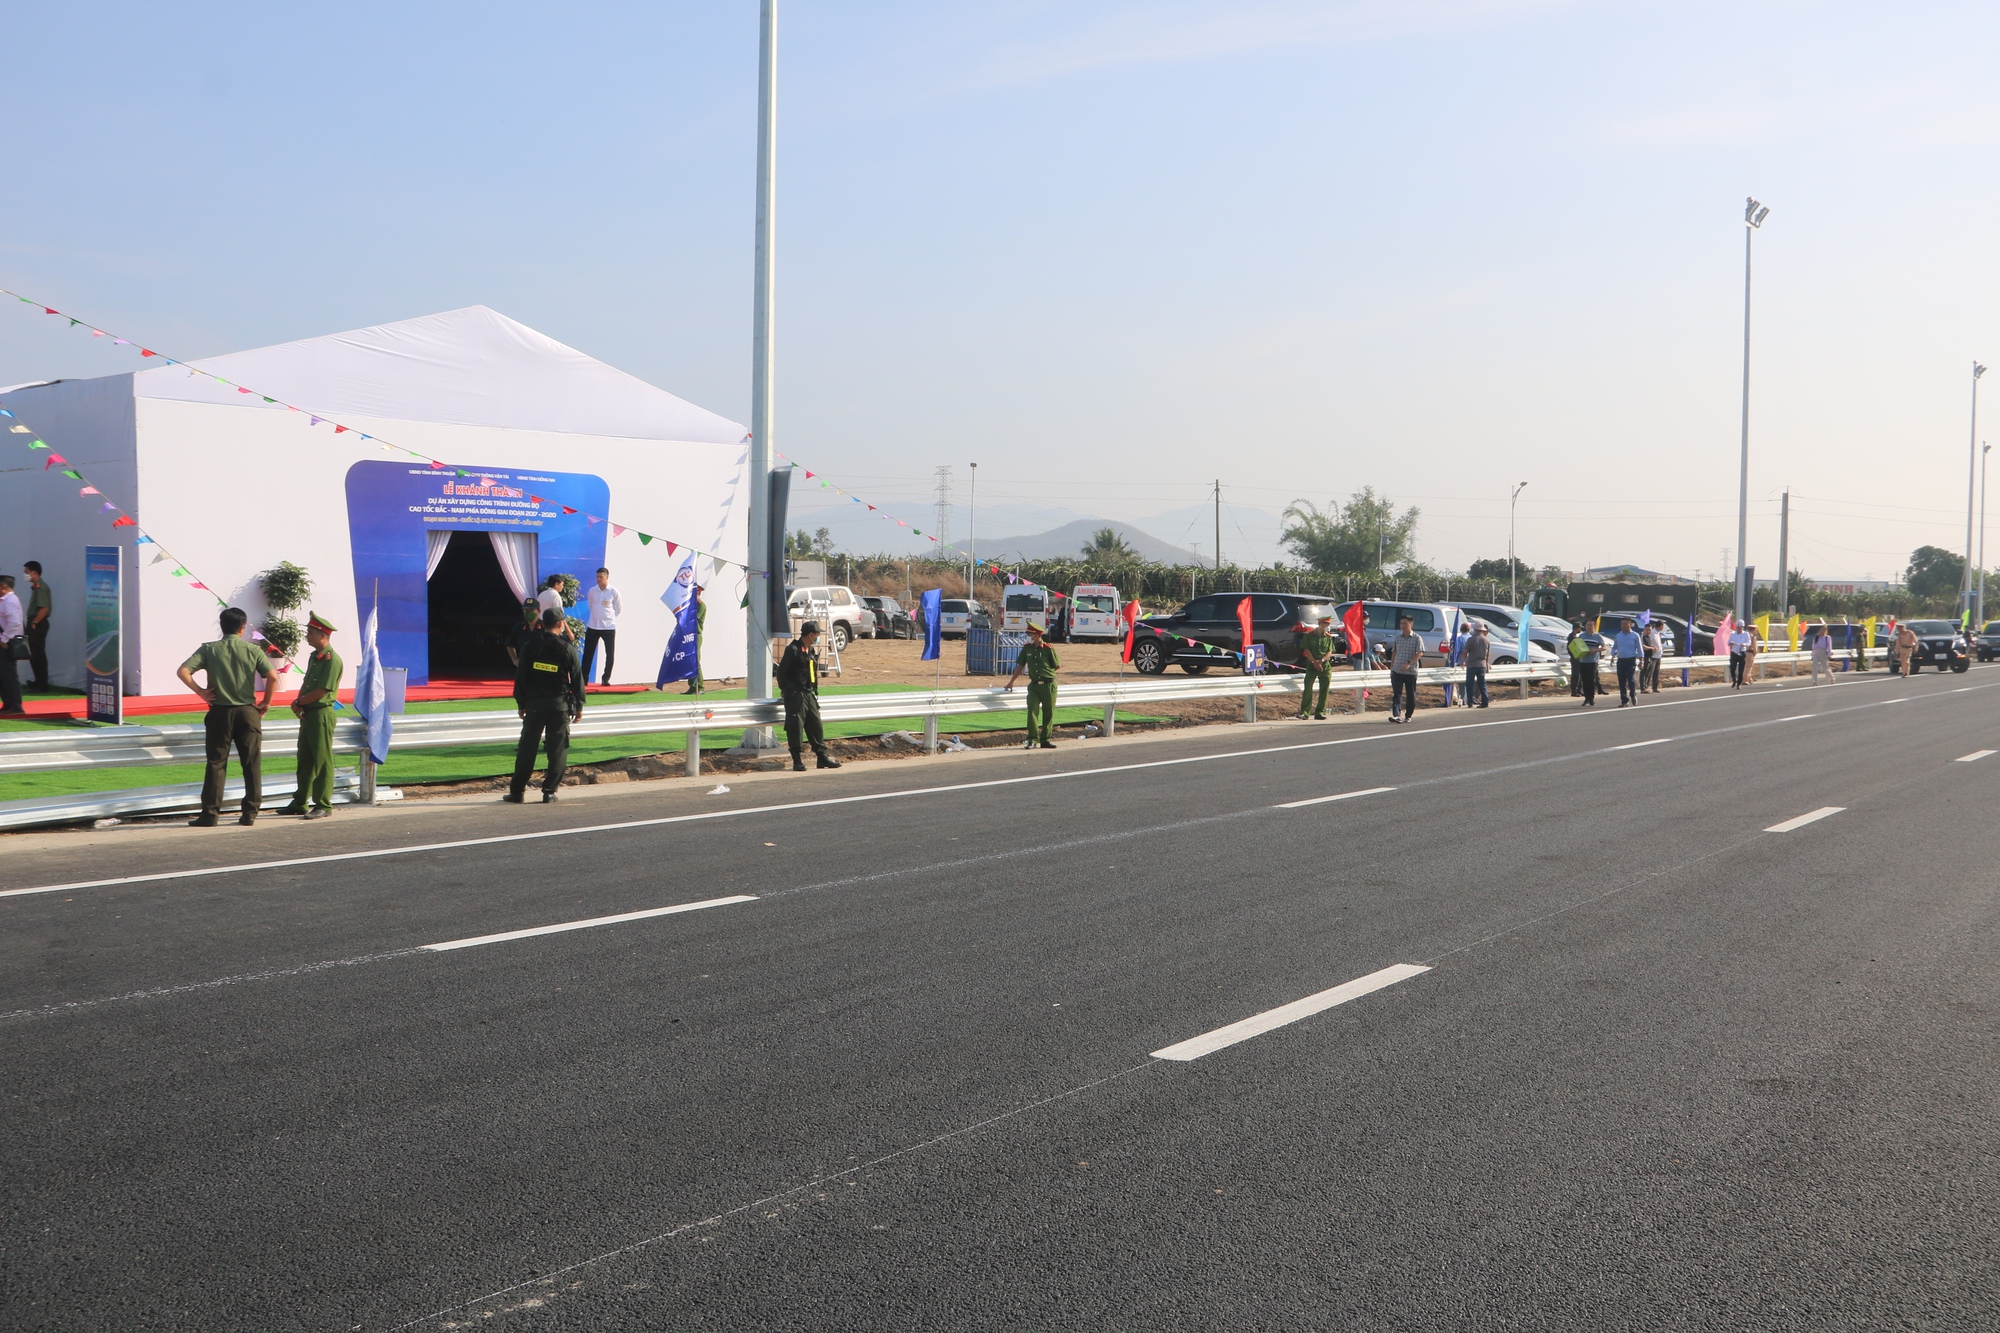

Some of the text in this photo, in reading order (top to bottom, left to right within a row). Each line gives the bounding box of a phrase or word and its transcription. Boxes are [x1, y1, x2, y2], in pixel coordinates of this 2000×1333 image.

[444, 480, 522, 498] LỄ KHÁNH THÀH
[422, 504, 434, 512] TỐC
[435, 505, 448, 513] BẮC
[510, 500, 530, 508] ĐƯỜNG
[1247, 648, 1255, 668] P
